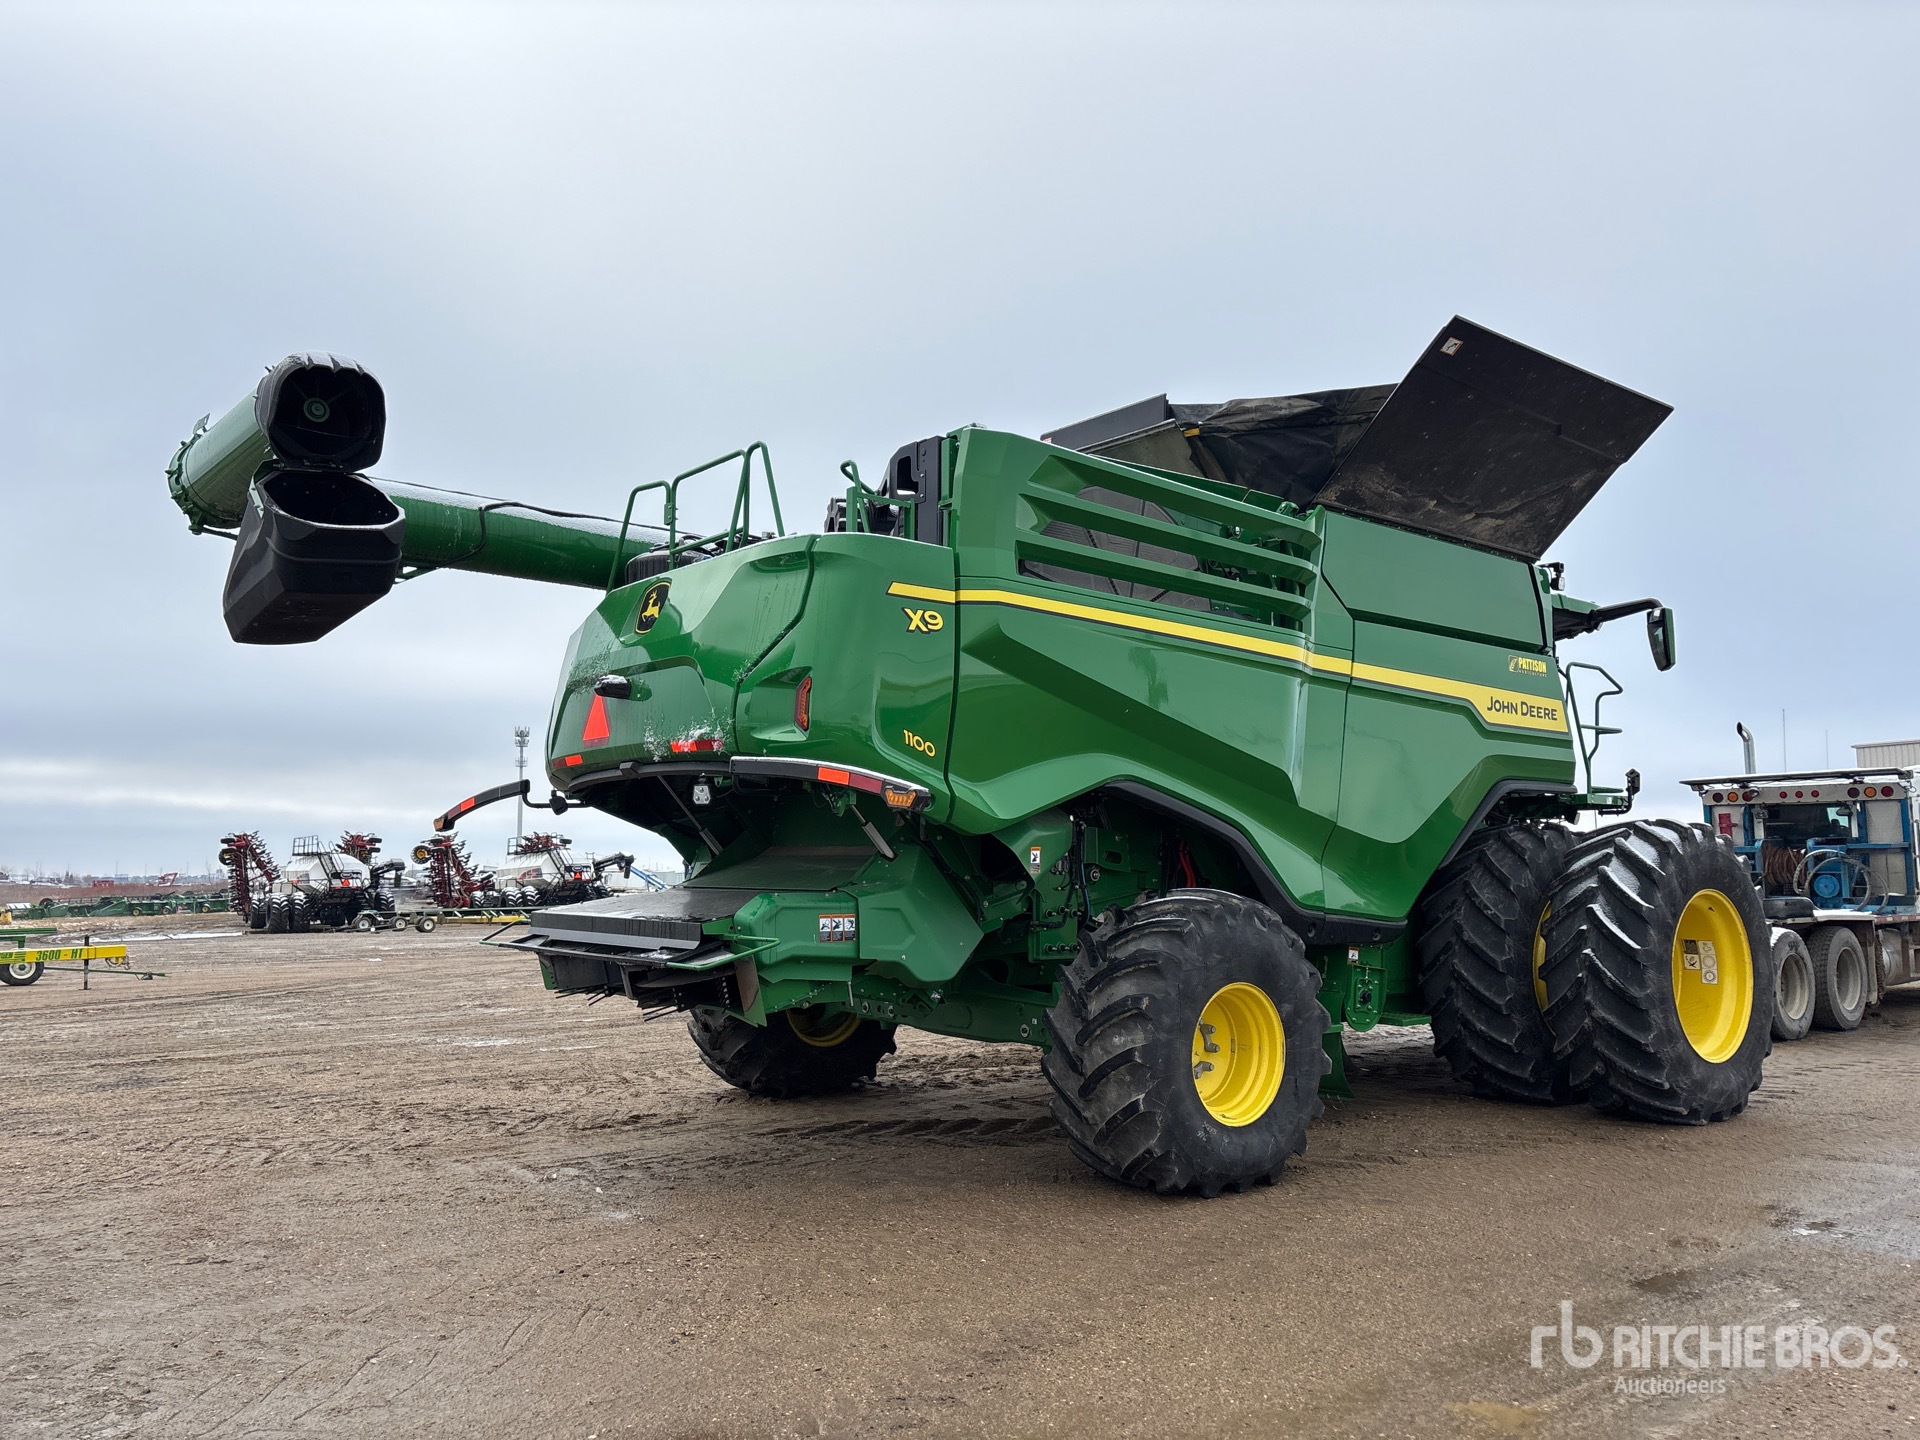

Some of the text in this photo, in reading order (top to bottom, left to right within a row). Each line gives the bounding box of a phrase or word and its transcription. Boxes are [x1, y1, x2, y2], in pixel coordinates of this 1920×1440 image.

[902, 607, 944, 634] X9
[1518, 656, 1547, 673] PATTISON
[1487, 696, 1558, 721] JOHN DEERE
[903, 729, 936, 757] 1100
[36, 949, 61, 961] 3600
[71, 948, 84, 959] HT
